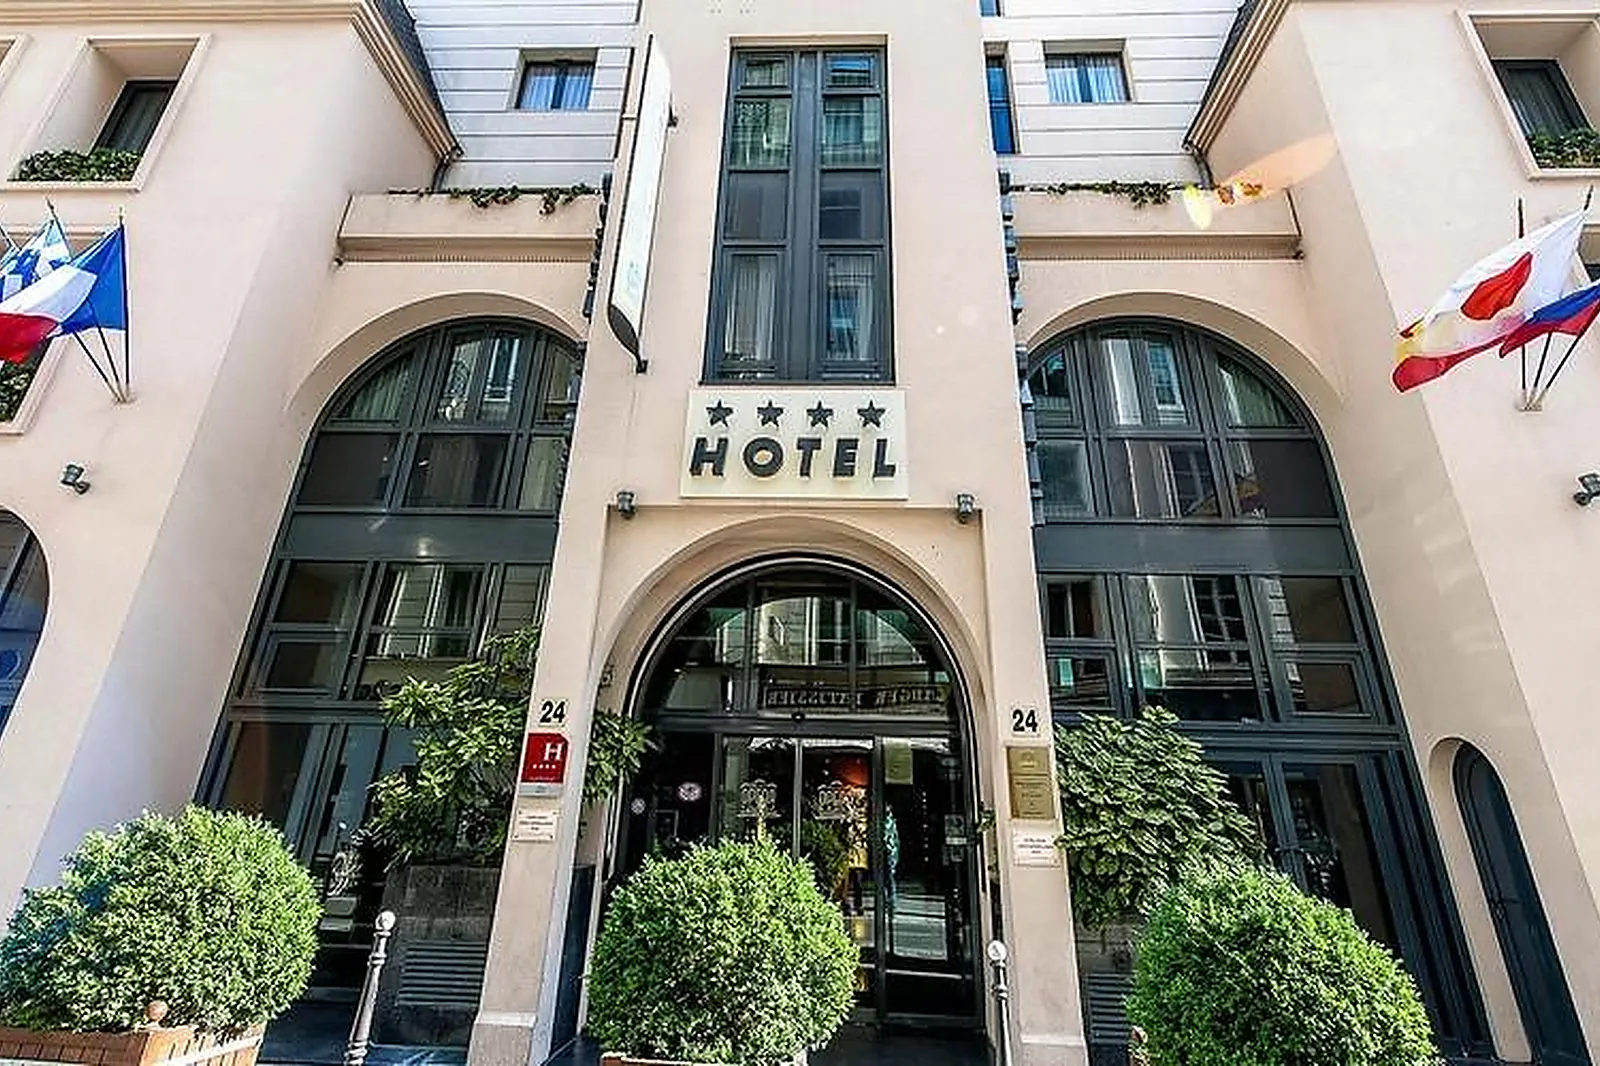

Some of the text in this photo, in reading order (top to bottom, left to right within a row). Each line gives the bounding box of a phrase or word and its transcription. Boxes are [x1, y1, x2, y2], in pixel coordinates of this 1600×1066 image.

[689, 437, 896, 477] HOTEL
[540, 701, 566, 723] 24
[1012, 709, 1038, 732] 24
[544, 743, 562, 761] H
